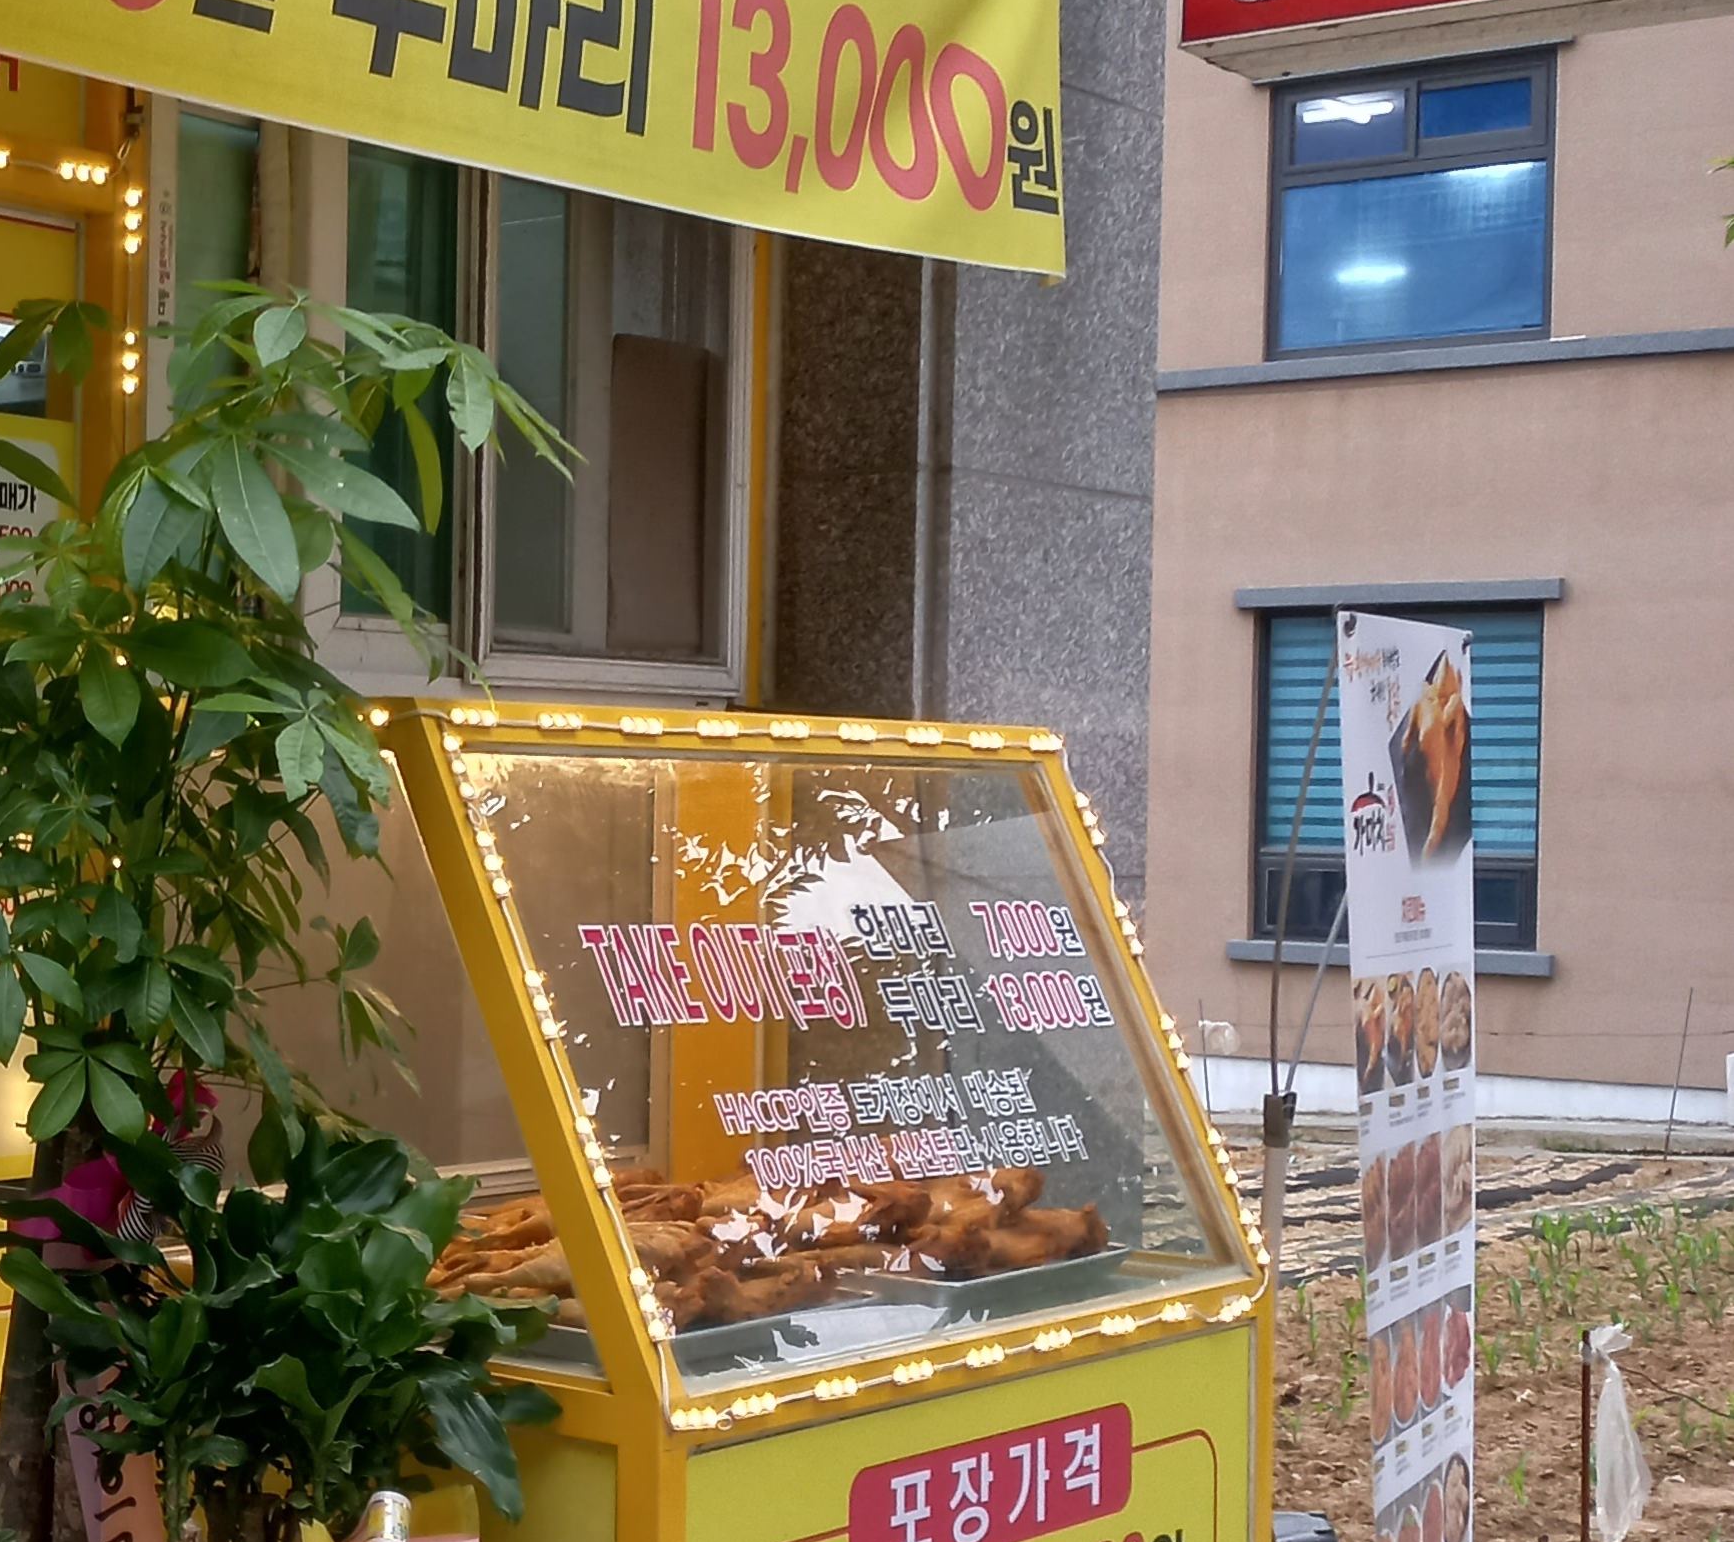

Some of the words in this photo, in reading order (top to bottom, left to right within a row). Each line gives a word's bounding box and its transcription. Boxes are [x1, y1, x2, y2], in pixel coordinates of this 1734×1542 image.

[579, 924, 707, 1027] TAKE
[850, 900, 956, 960] 한마리
[969, 900, 1086, 961] 7,000원
[877, 975, 987, 1038] 두마리
[986, 970, 1115, 1034] 13,000원
[713, 1082, 852, 1136] HACCP인증
[848, 1072, 968, 1127] 도계장에서
[962, 1067, 1037, 1118] 배송된
[979, 1113, 1089, 1170] 사용합니다
